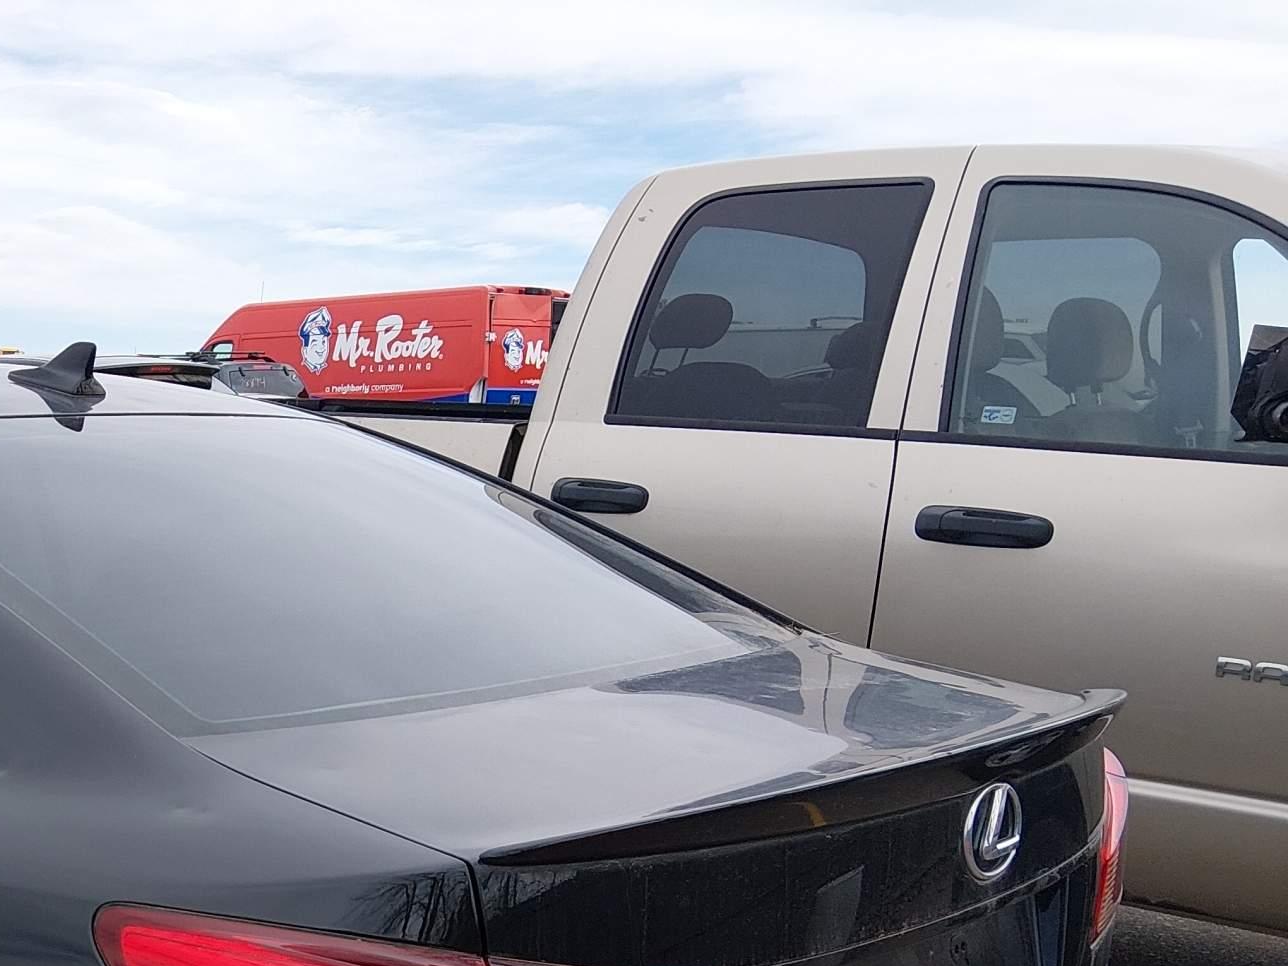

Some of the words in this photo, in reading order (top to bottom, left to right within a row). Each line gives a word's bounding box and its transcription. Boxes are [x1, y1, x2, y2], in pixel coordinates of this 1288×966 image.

[332, 320, 374, 368] Mr.
[360, 362, 432, 374] PLUMBING
[331, 383, 370, 395] neighborly
[371, 383, 404, 393] company
